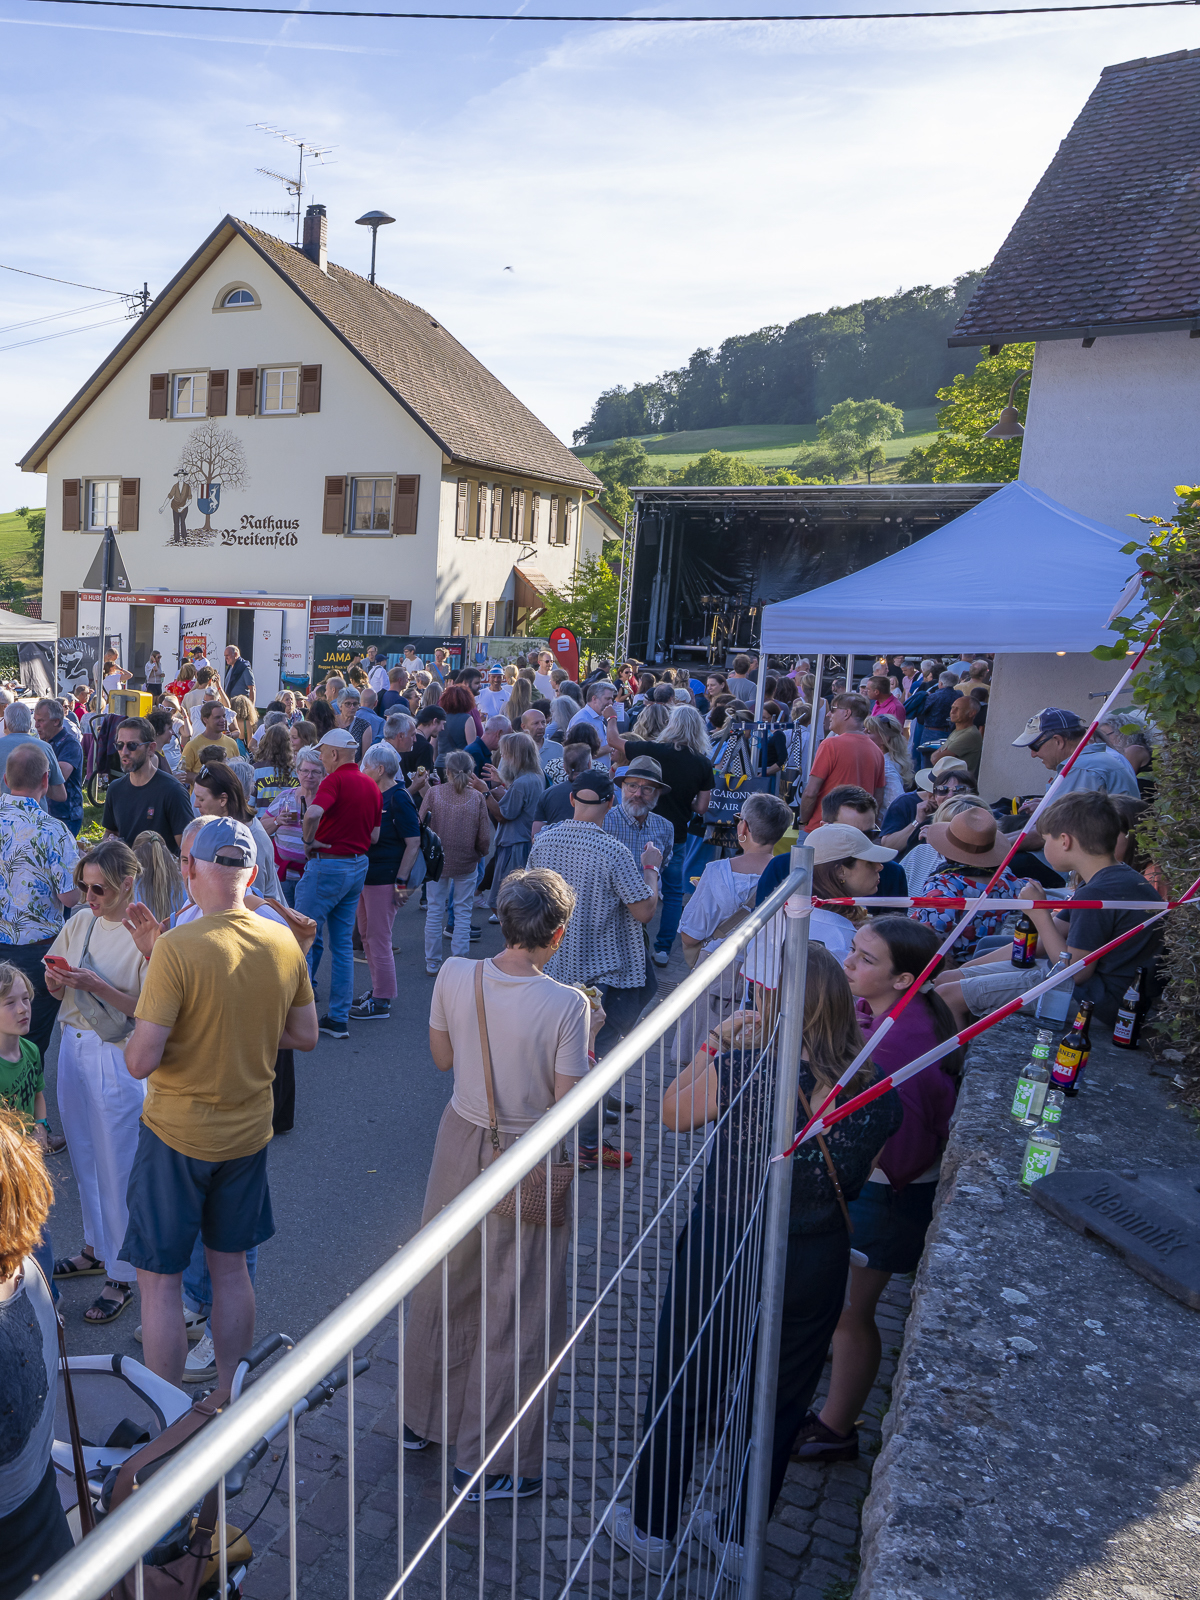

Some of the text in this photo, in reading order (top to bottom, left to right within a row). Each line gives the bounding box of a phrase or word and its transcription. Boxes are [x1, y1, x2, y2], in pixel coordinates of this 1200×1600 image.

[240, 514, 300, 533] Rathaus
[220, 529, 299, 549] Breitenfeld
[248, 600, 304, 608] www.huber-dienste.de
[316, 605, 331, 613] HUBER
[86, 624, 112, 632] Bierwen
[180, 617, 212, 630] anzt der
[708, 800, 739, 811] EN AIR
[1081, 1182, 1189, 1255] klemmfix
